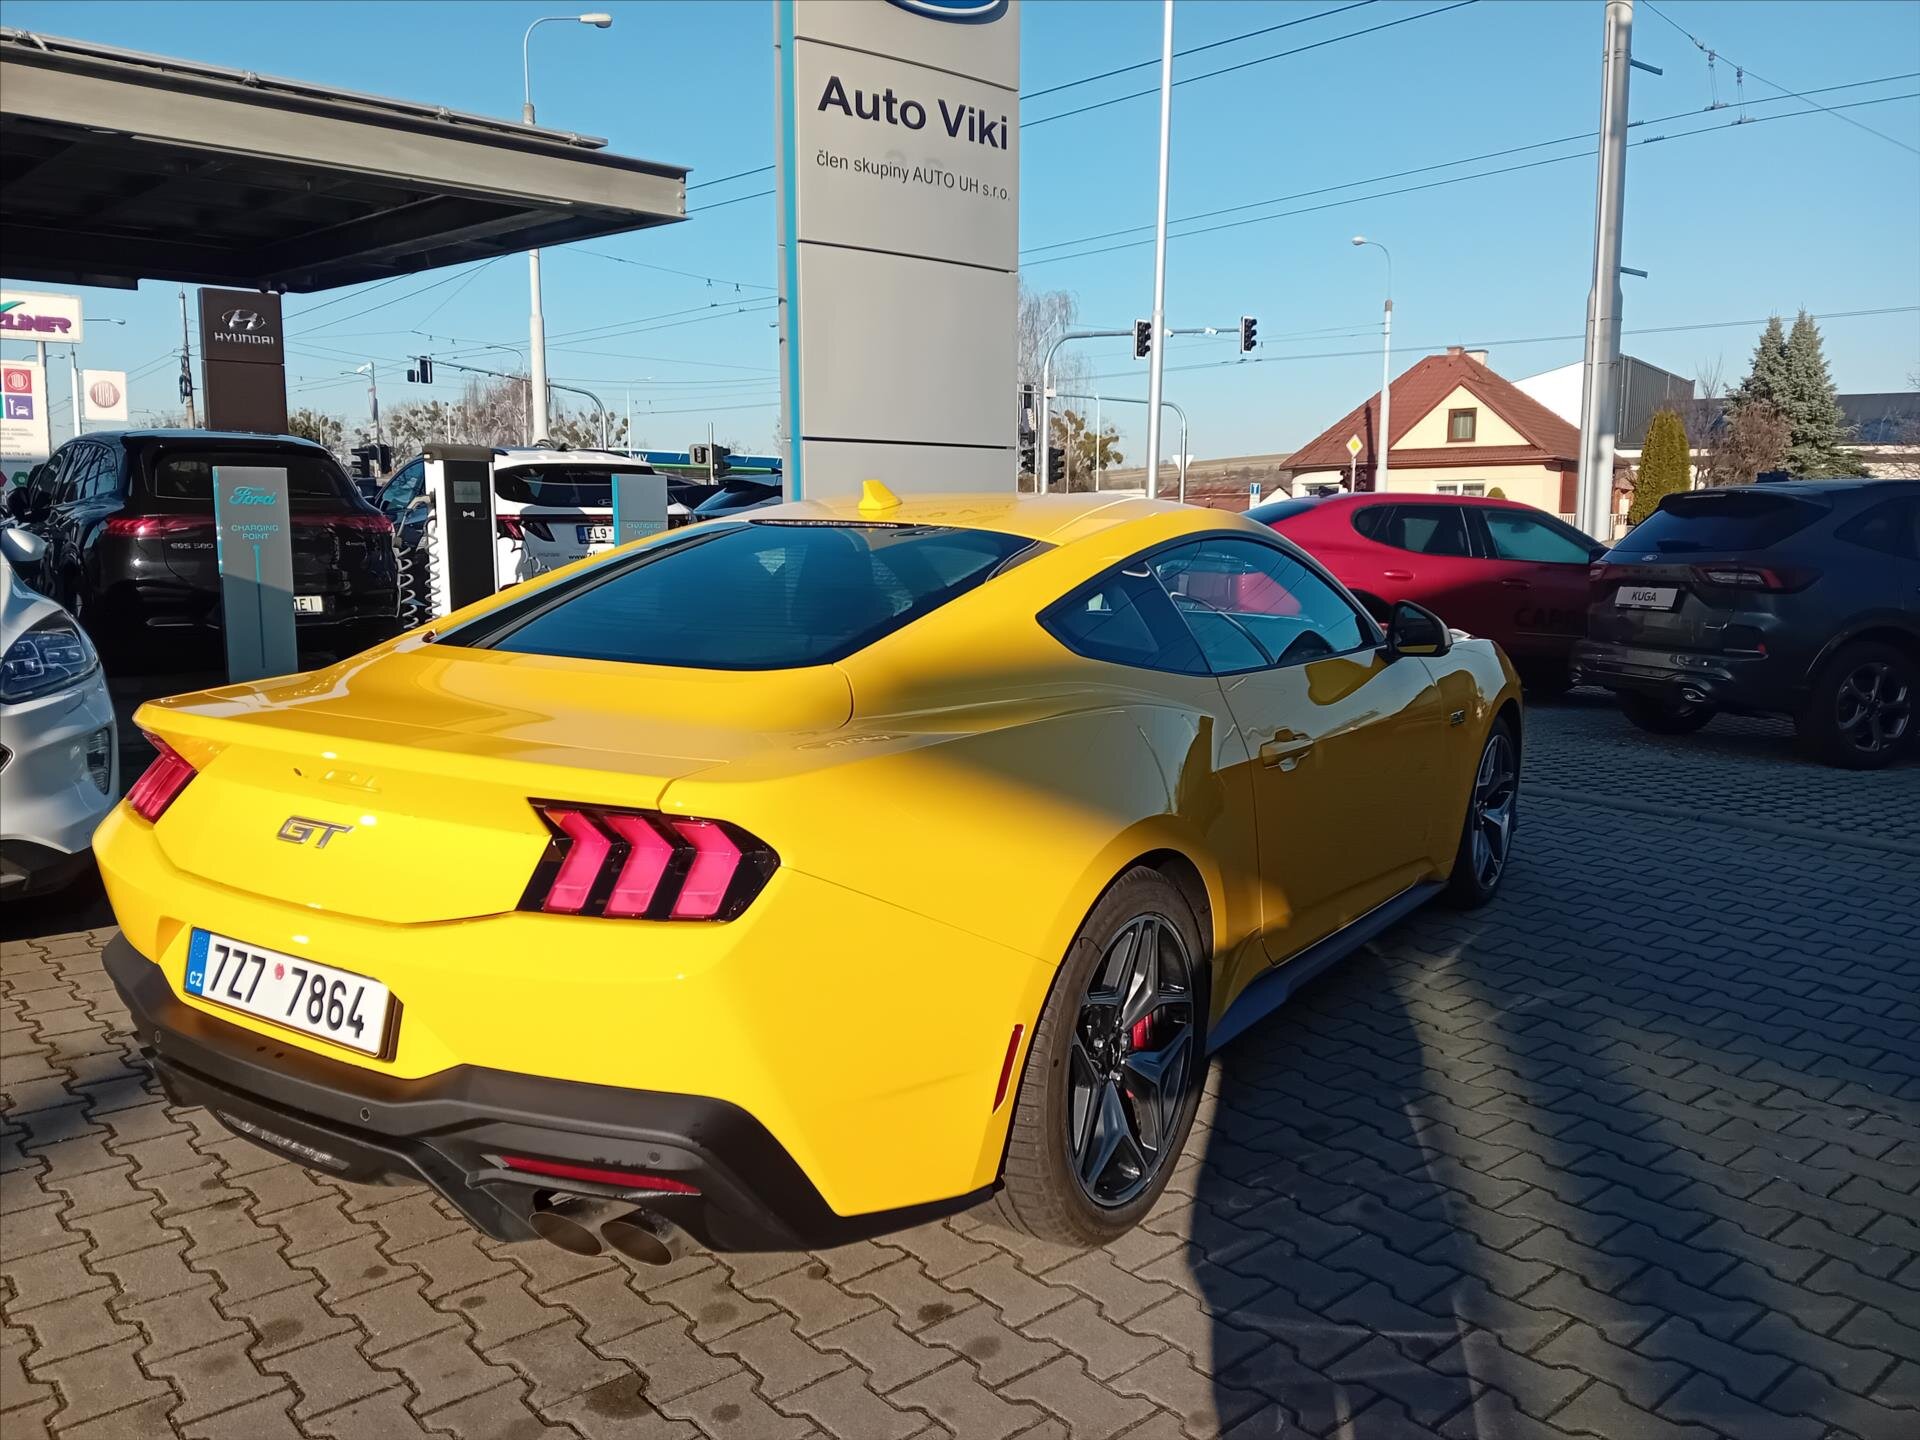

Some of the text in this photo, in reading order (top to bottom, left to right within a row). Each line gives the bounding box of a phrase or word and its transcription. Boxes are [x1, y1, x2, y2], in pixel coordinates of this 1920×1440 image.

[817, 75, 1007, 150] Auto Viki
[816, 150, 1011, 200] člen skupiny AUTO UH s.r.o.
[214, 331, 274, 344] HYUNDAI
[228, 486, 277, 505] Ford
[231, 524, 279, 532] CHARGING
[586, 527, 608, 539] EL9
[1630, 591, 1657, 602] KUGA
[277, 814, 354, 849] GT
[189, 971, 203, 987] CZ
[209, 943, 365, 1039] 7Z7 7864
